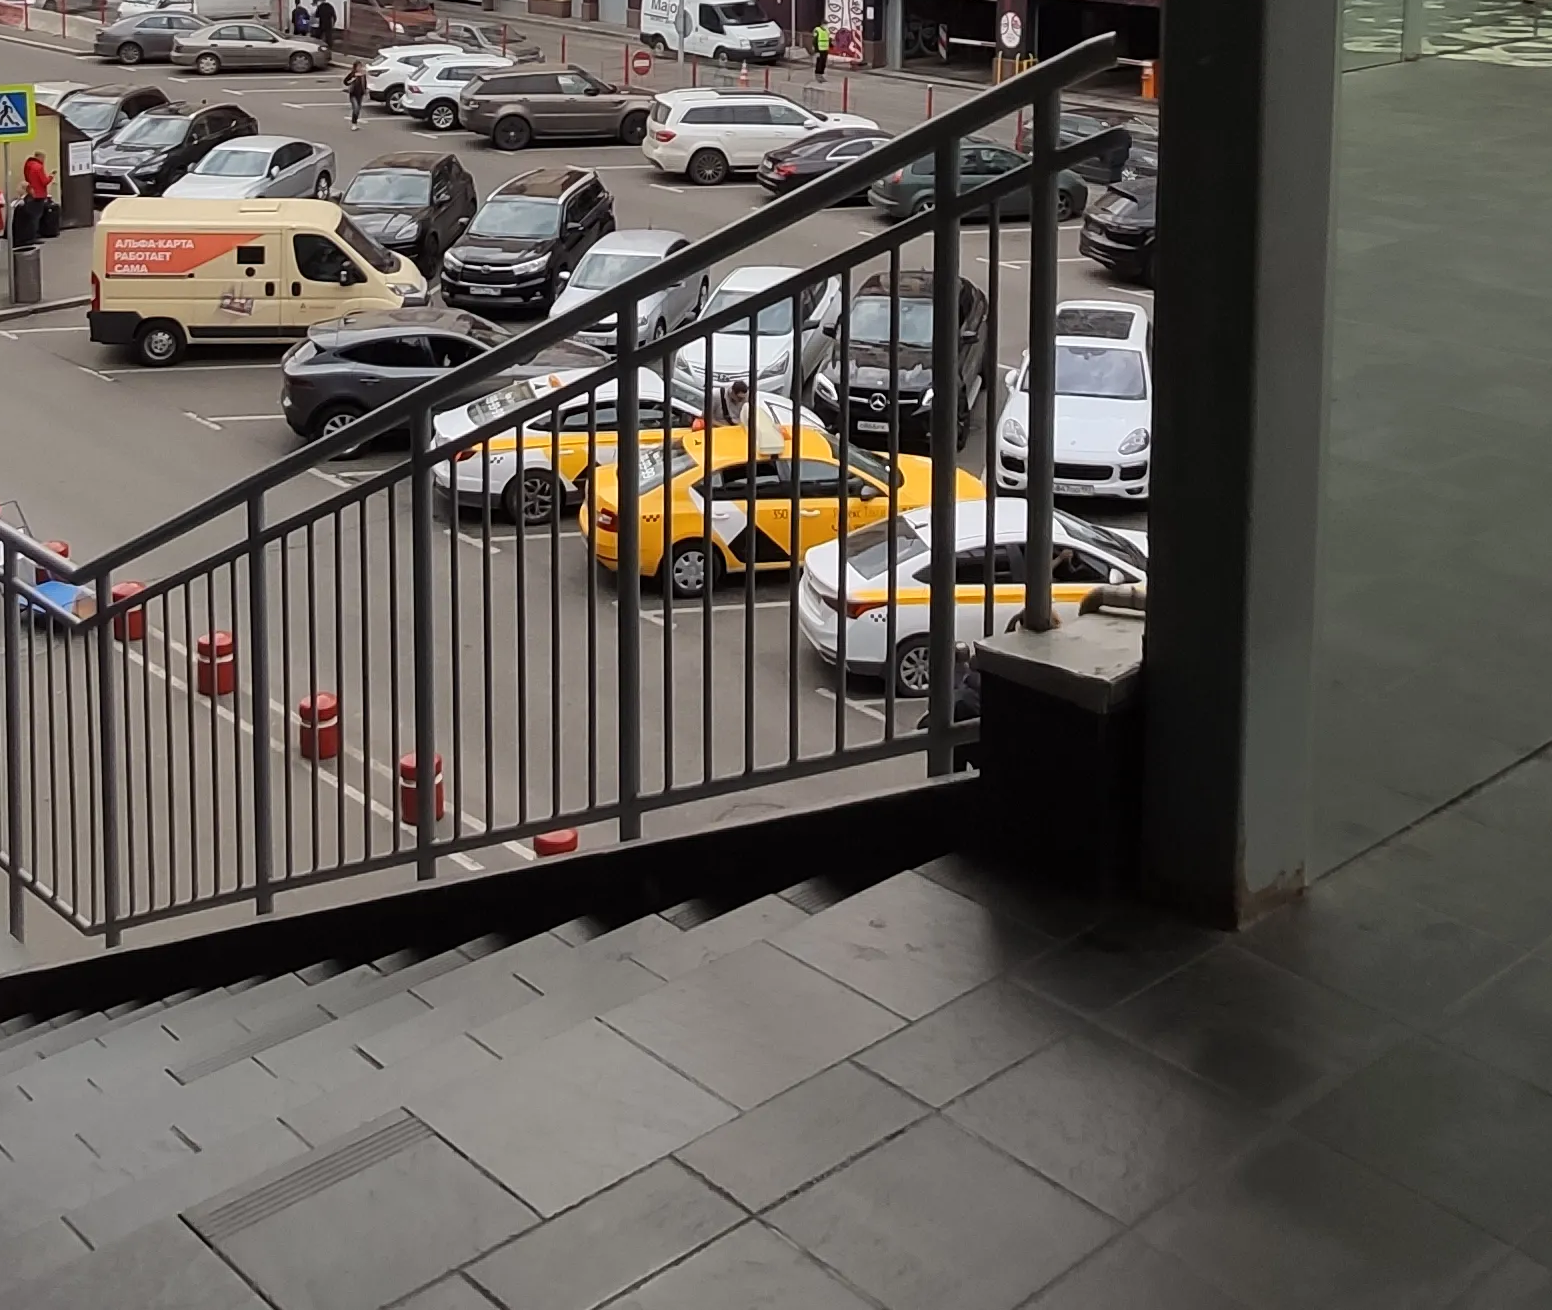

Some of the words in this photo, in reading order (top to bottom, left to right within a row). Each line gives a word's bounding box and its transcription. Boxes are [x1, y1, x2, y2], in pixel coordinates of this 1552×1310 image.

[115, 239, 194, 248] АЛЬФА-КАРТА
[114, 251, 172, 261] РАБОТАЕТ
[114, 264, 148, 273] САМА
